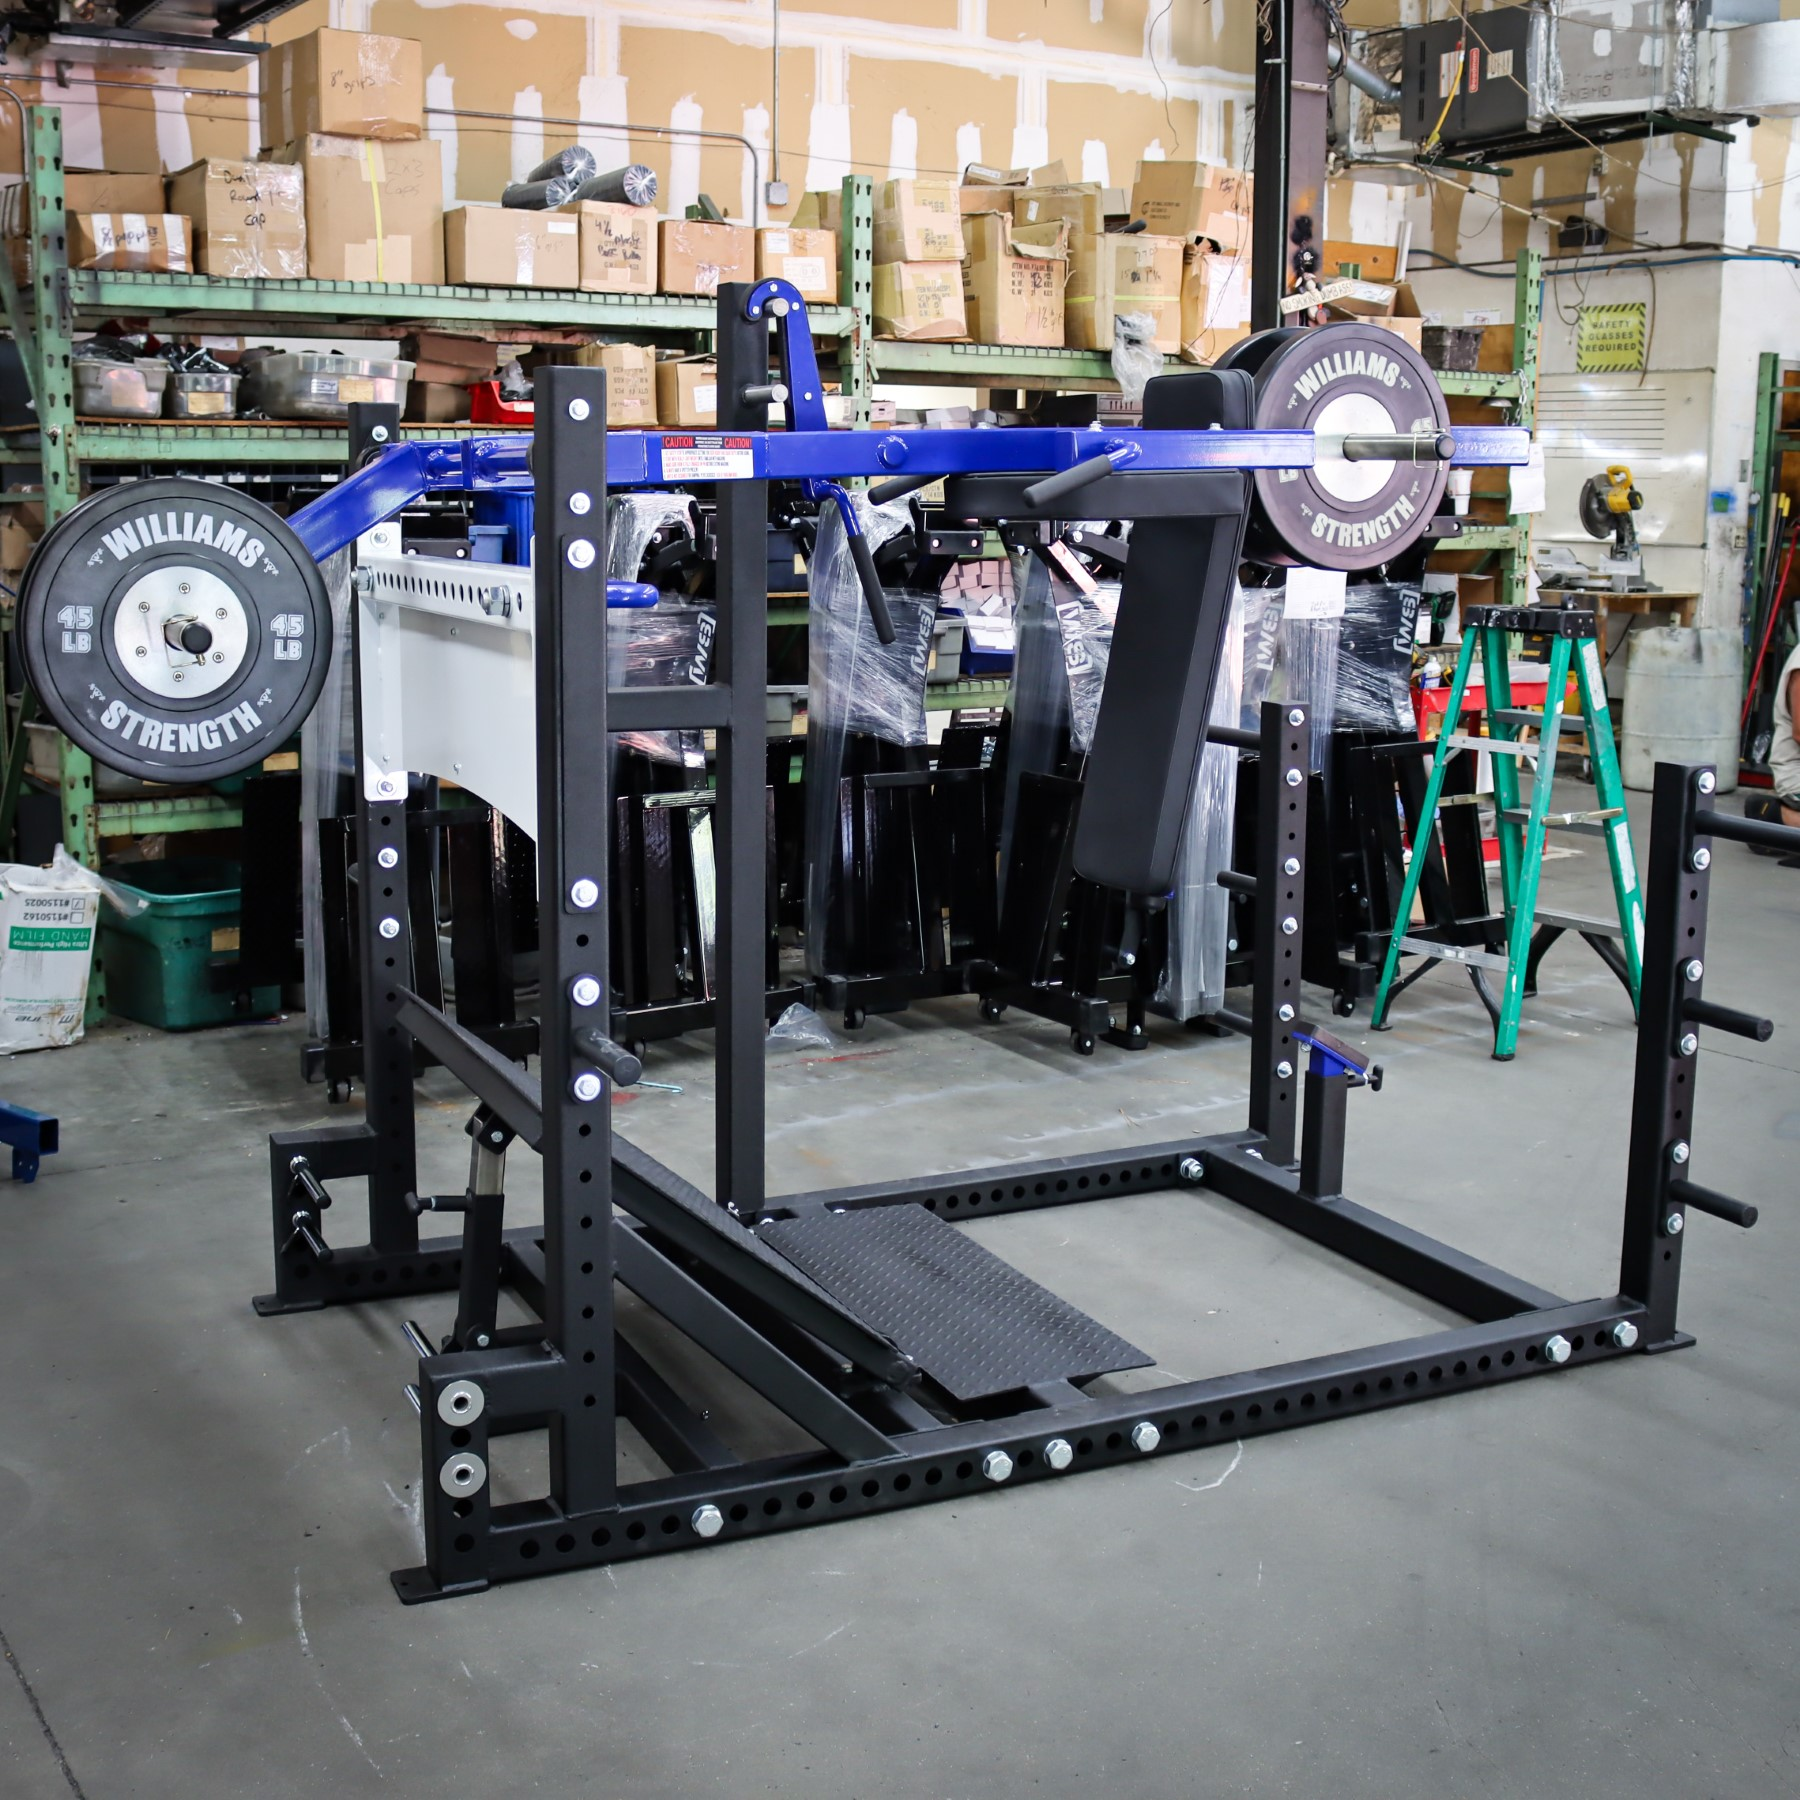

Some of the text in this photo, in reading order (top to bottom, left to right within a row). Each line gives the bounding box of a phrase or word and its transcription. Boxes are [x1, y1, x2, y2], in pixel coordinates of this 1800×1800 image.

[1592, 320, 1630, 329] SAFETY
[1588, 331, 1634, 341] GLASSES
[1585, 343, 1637, 352] REQUIRED
[1294, 350, 1401, 401] WILLIAMS
[1311, 494, 1415, 547] STRENGTH
[101, 511, 265, 568] WILLIAMS
[57, 605, 93, 630] 45
[270, 613, 304, 637] 45
[61, 631, 92, 653] LB
[274, 639, 302, 660] LB
[100, 700, 262, 752] STRENGTH
[25, 898, 70, 907] #1150025
[23, 912, 69, 921] #1150162
[13, 930, 90, 940] HAND FILM
